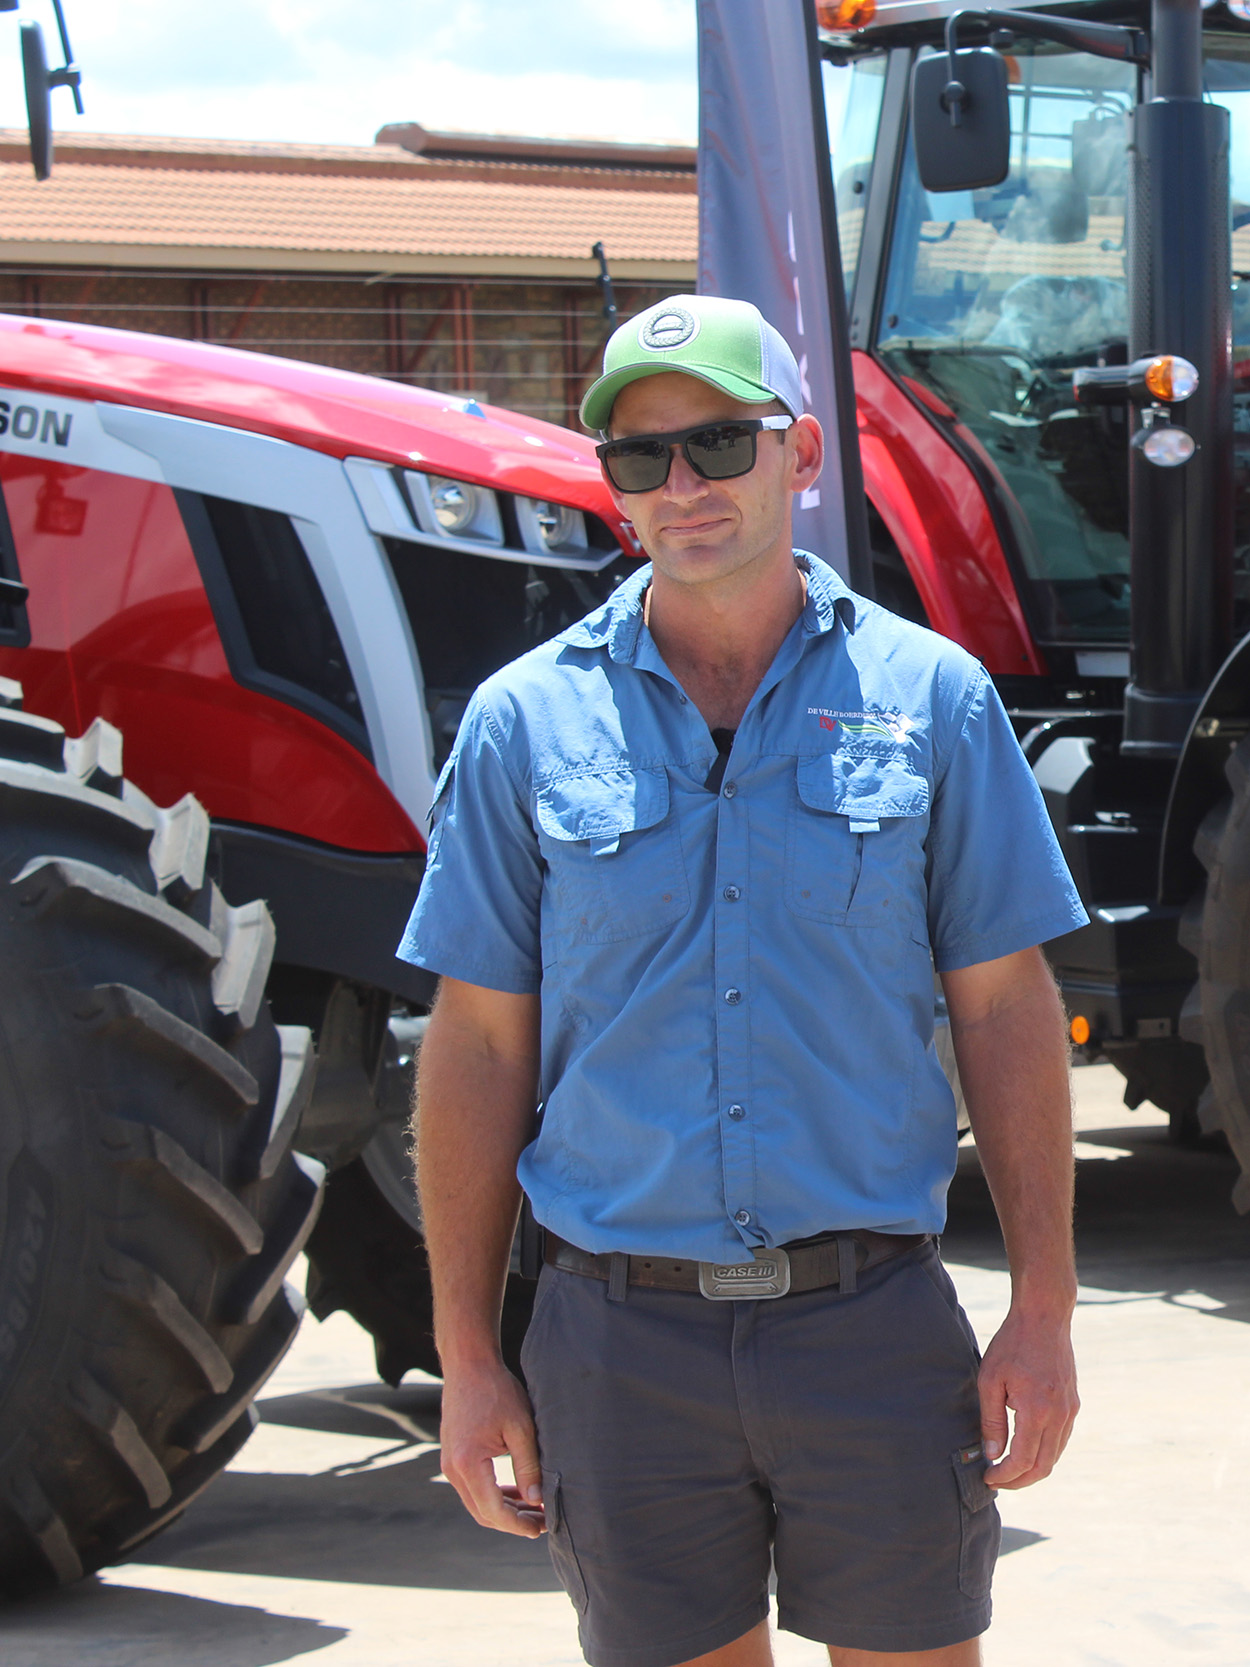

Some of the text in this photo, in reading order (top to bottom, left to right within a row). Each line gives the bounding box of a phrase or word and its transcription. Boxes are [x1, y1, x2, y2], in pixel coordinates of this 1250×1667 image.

[808, 707, 818, 715] DE
[818, 708, 839, 718] VILLE
[716, 1267, 758, 1277] CASE
